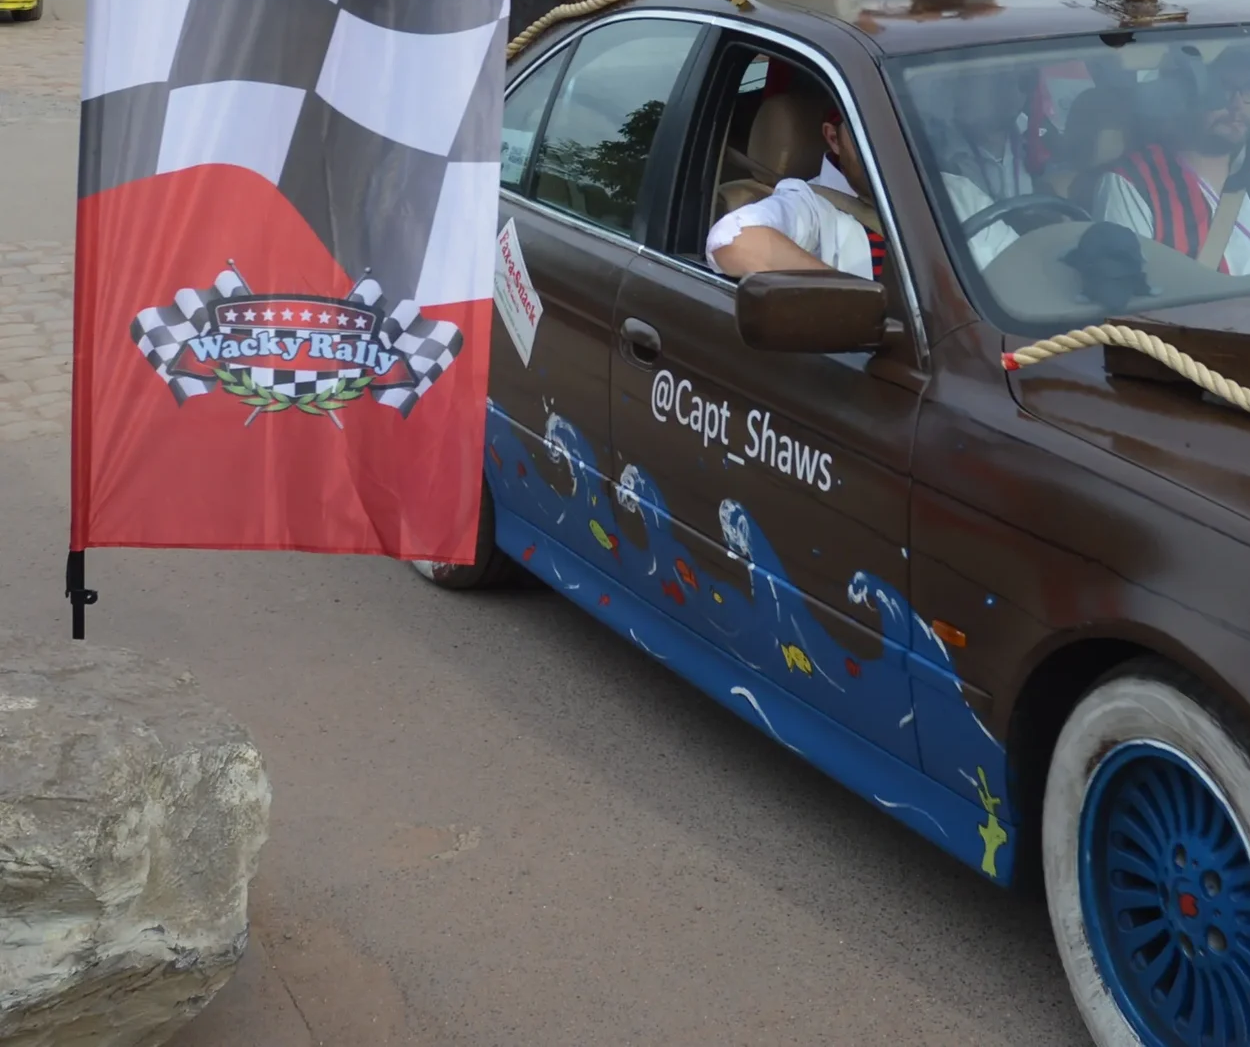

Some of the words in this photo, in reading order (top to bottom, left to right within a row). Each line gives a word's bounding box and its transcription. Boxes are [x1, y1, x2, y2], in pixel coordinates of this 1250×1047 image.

[187, 330, 304, 363] Wacky
[308, 332, 399, 375] Rally
[651, 369, 833, 492] @Capt_Shaws
